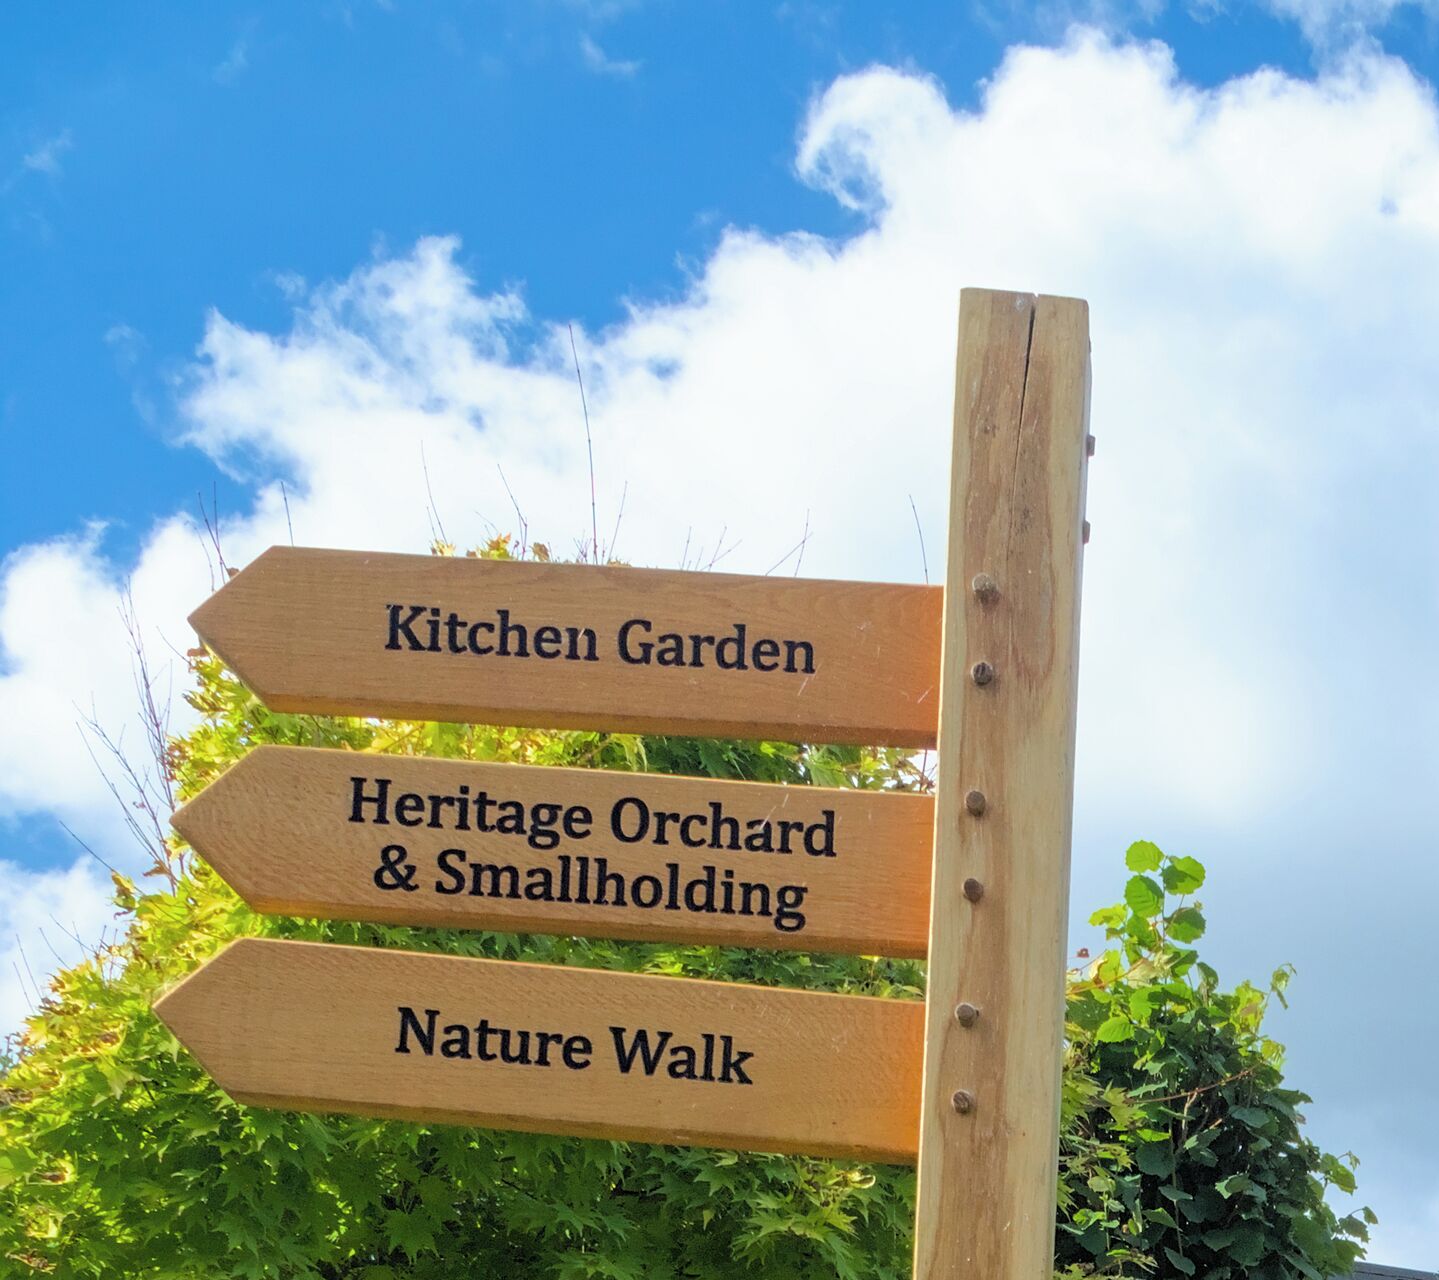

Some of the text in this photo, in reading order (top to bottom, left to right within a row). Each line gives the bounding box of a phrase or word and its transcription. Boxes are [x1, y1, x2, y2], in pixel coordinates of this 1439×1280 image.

[384, 603, 817, 675] Kitchen Garden
[347, 776, 838, 858] Heritage Orchard
[373, 844, 808, 932] & Smallholding
[394, 1006, 755, 1086] Nature Walk
